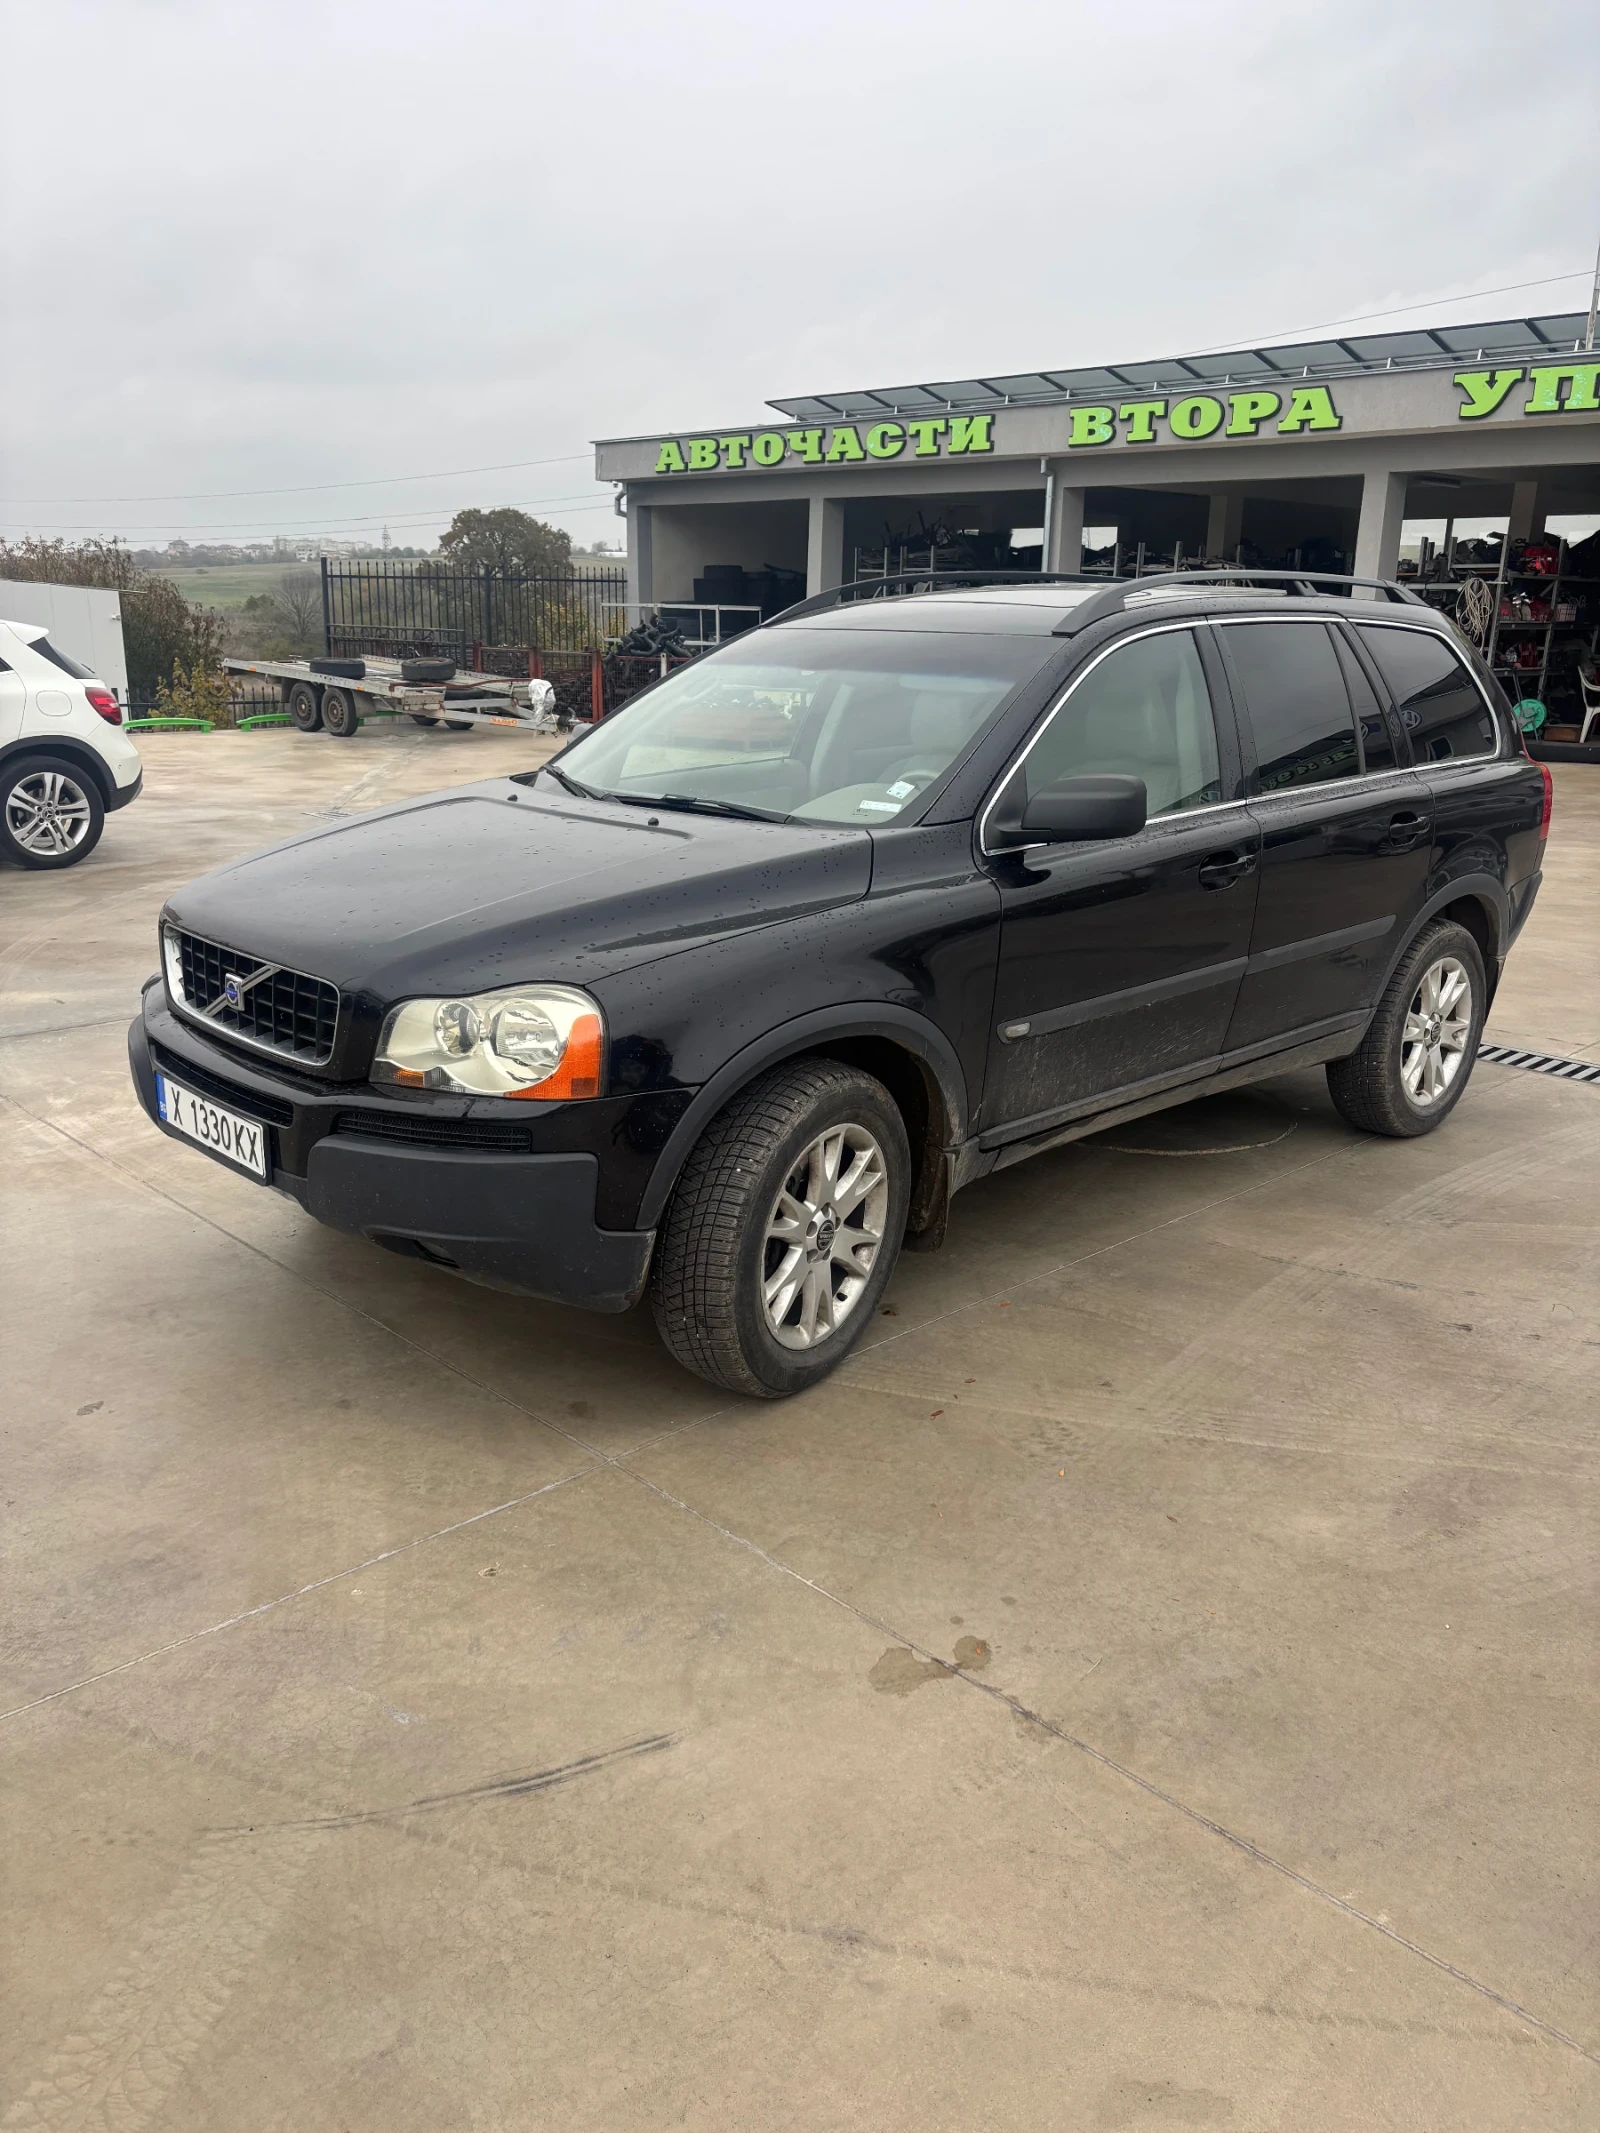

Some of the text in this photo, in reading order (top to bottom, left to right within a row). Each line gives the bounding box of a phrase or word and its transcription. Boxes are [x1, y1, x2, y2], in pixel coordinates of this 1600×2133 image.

[655, 415, 994, 472] АВТОЧАСТИ
[1068, 386, 1341, 446] ВТОРА
[171, 1086, 183, 1126] X
